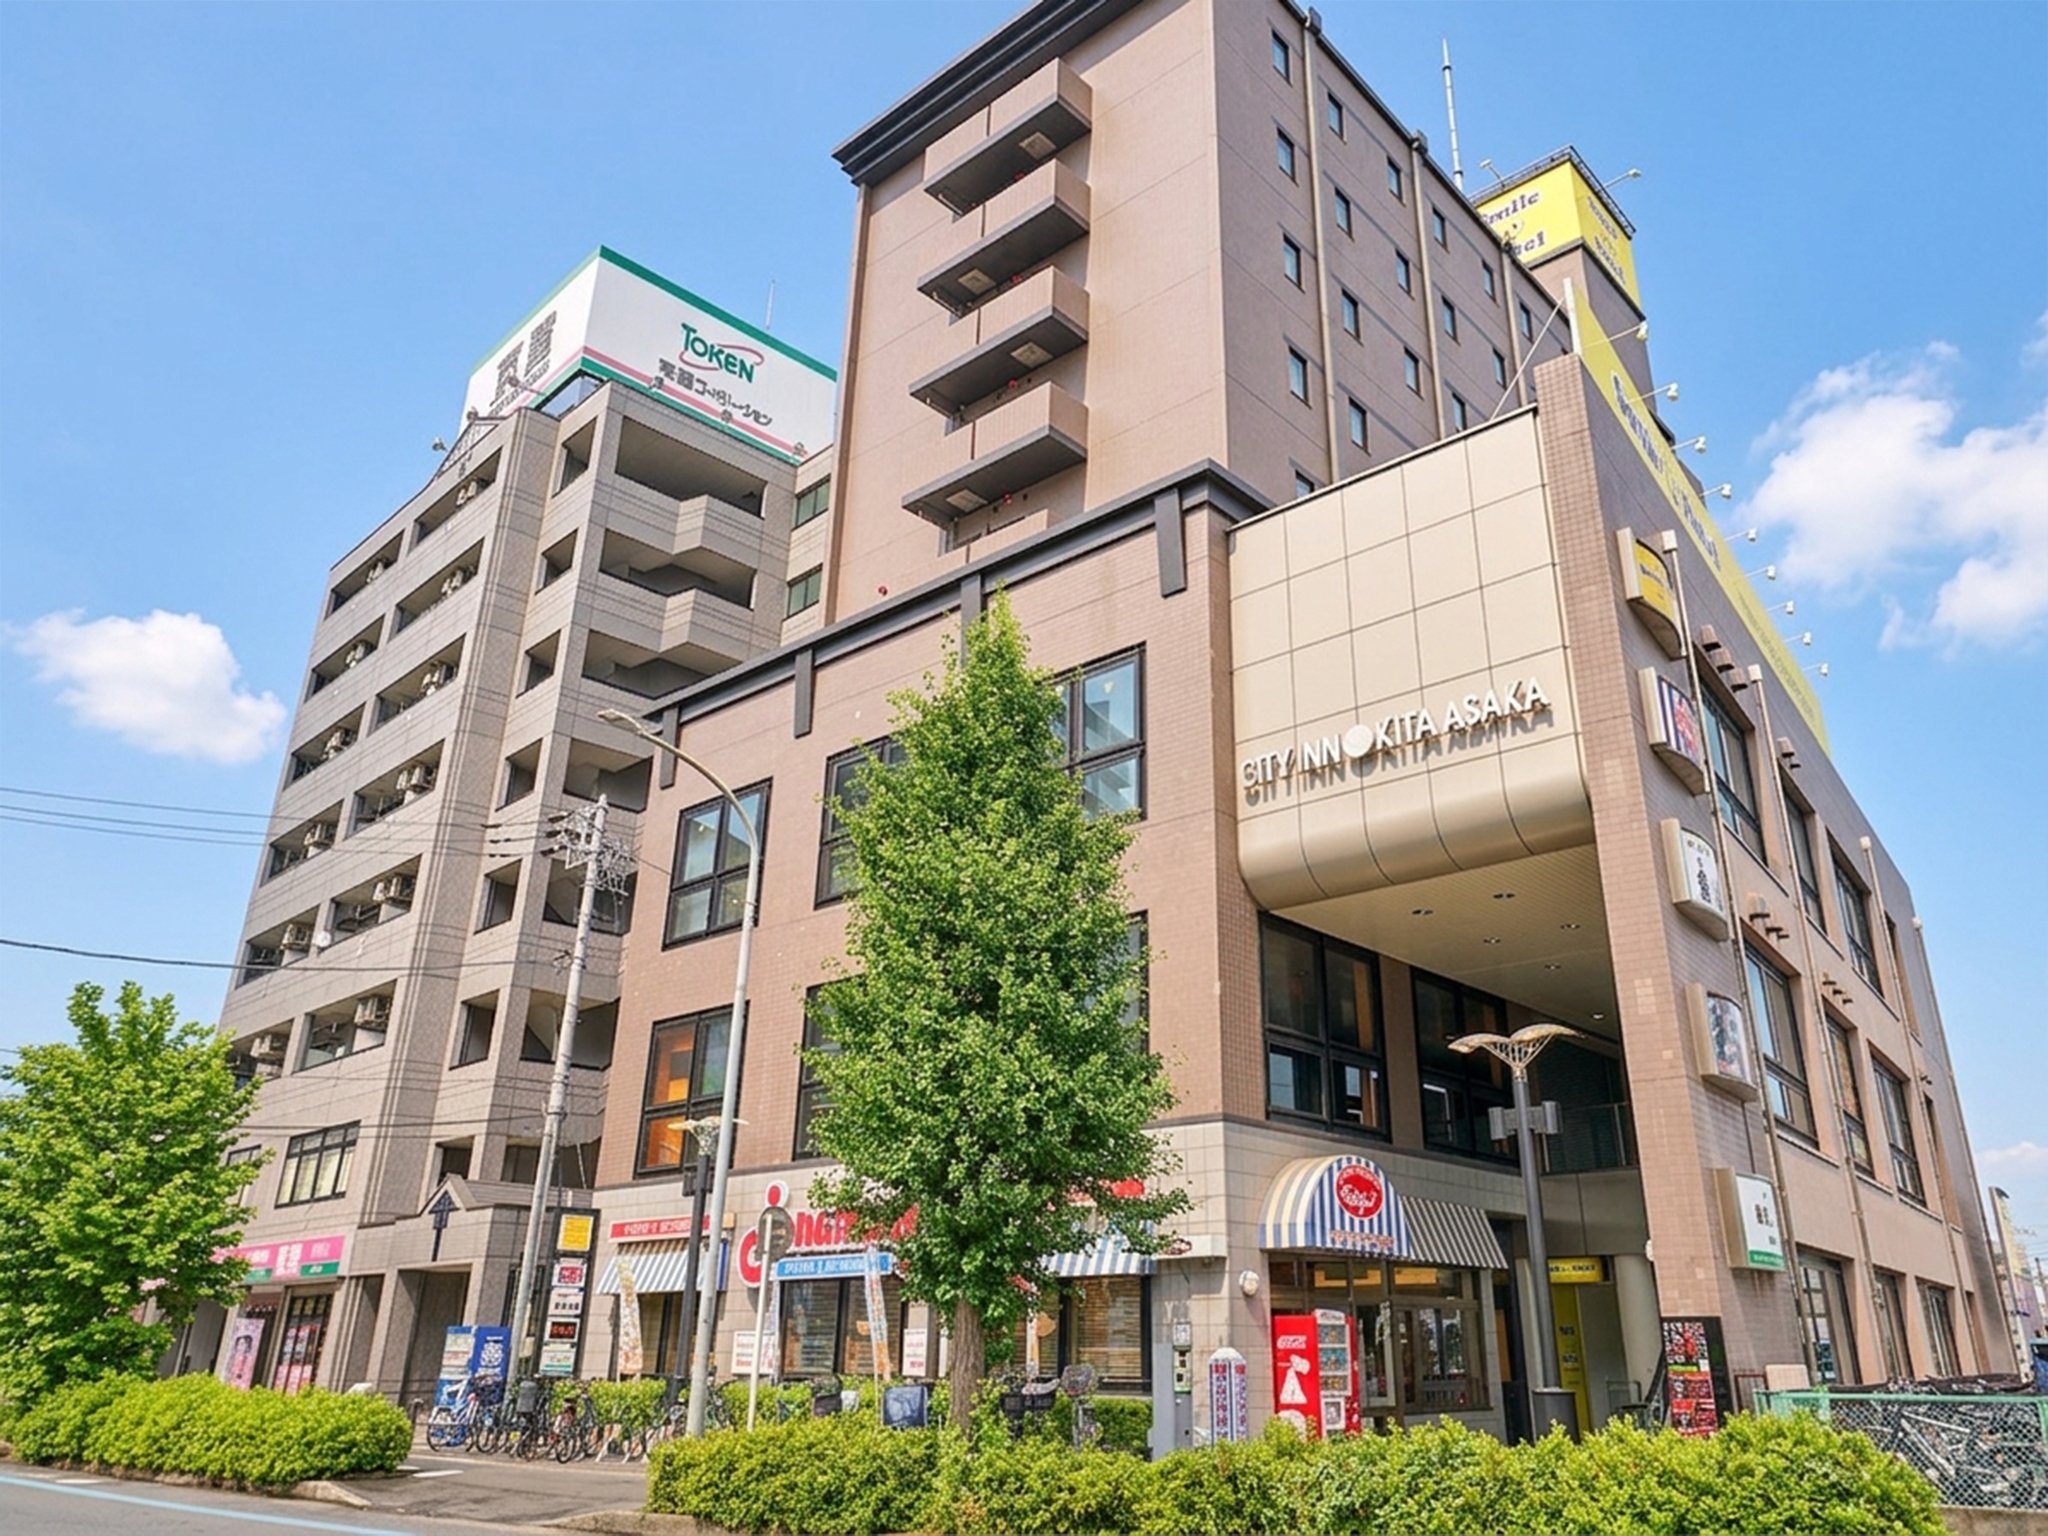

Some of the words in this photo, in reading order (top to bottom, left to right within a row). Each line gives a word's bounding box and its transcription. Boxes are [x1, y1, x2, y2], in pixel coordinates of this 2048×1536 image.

[681, 322, 755, 384] TOKEN
[1375, 708, 1439, 751] KITA
[1443, 676, 1551, 735] ASAKA
